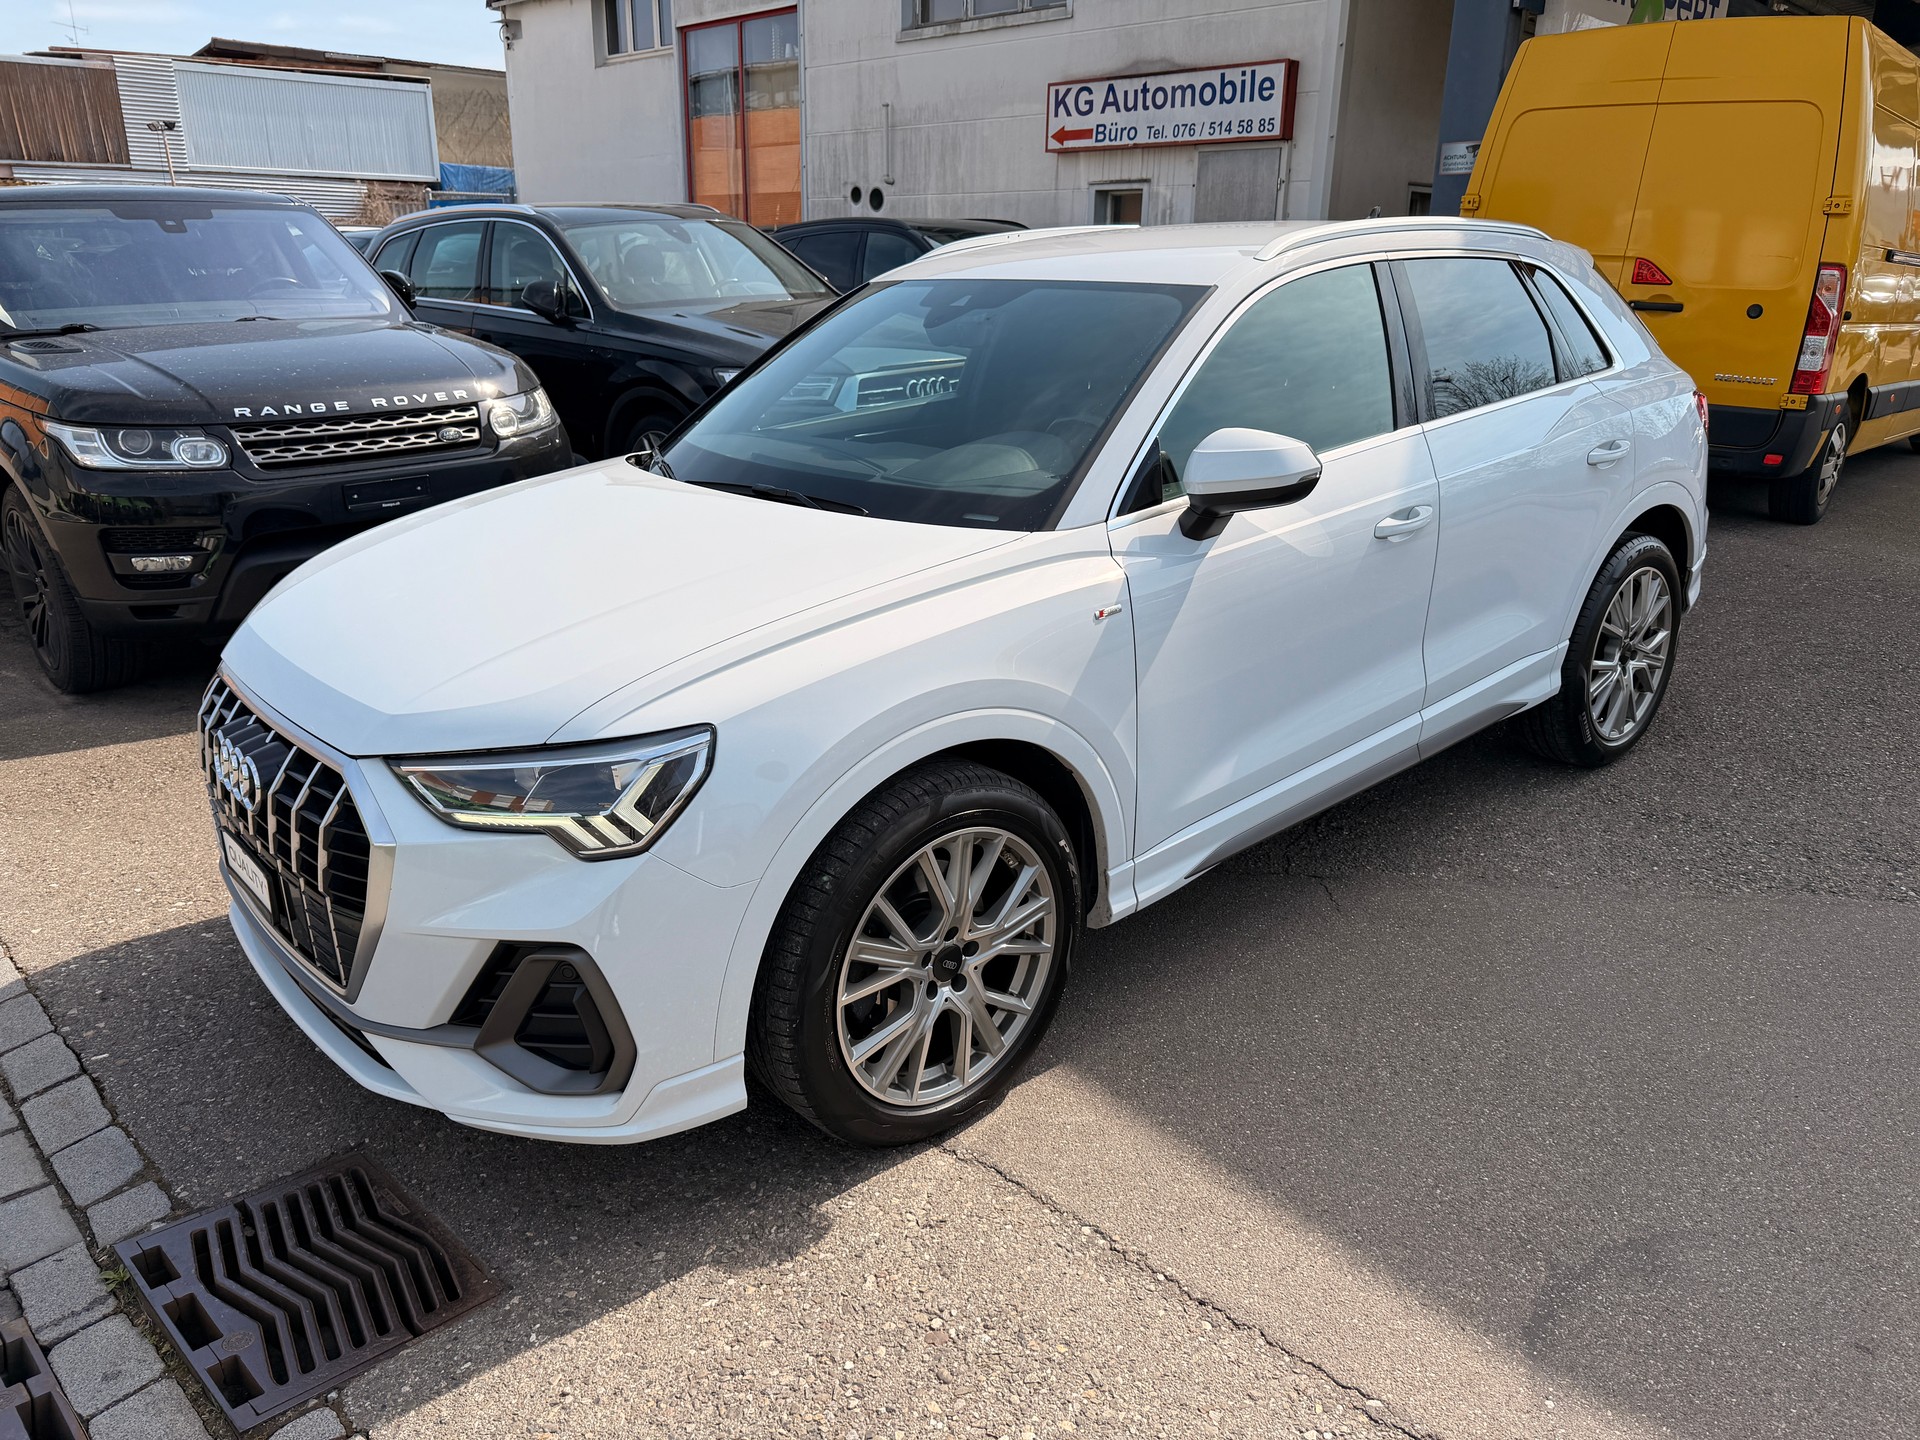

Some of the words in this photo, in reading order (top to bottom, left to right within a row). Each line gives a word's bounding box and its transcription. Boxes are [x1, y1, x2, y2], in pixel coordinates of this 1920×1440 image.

[1053, 85, 1094, 118] KG
[1100, 69, 1275, 115] Automobile
[1094, 122, 1138, 143] Büro
[1146, 125, 1168, 140] Tel.
[1172, 122, 1196, 138] 076
[1208, 119, 1235, 136] 514
[1237, 118, 1253, 135] 58
[1258, 117, 1275, 133] 85
[1714, 373, 1778, 386] RENAULT
[233, 400, 350, 418] RANGE
[371, 389, 469, 408] ROVER
